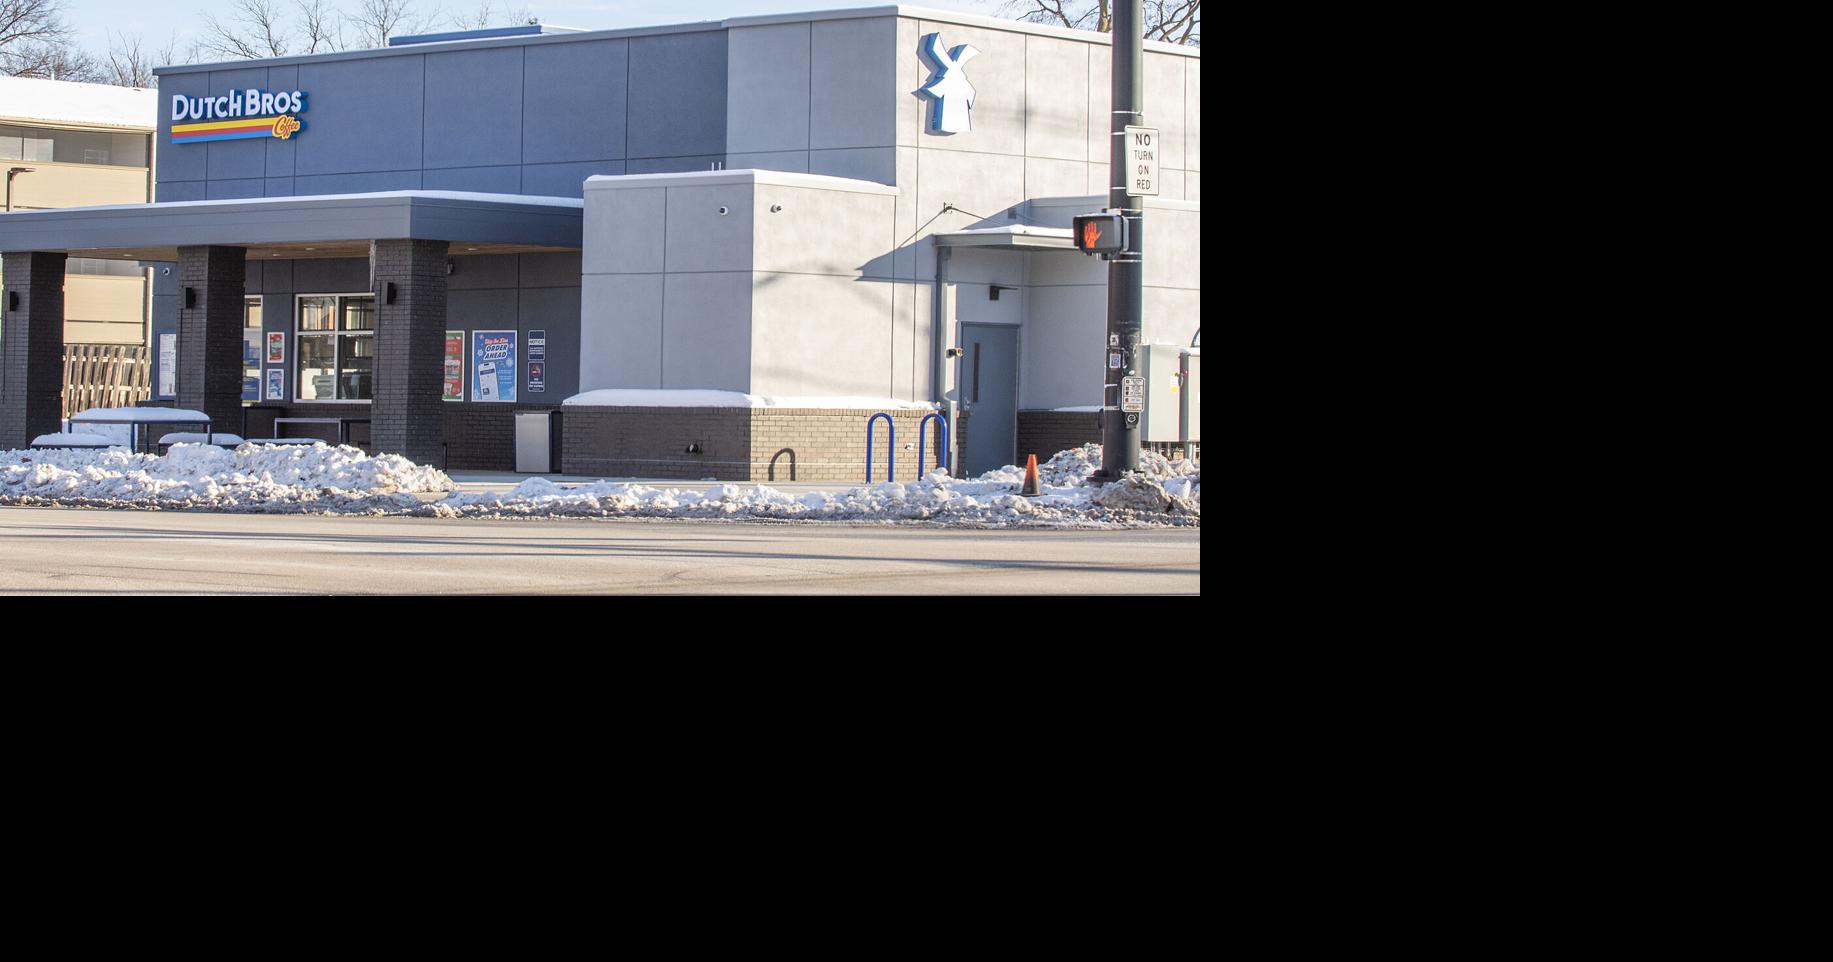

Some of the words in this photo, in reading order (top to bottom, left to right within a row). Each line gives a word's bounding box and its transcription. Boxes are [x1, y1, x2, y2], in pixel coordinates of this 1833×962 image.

[273, 115, 300, 139] Coffee
[1135, 133, 1151, 146] NO
[1133, 150, 1153, 161] TURN
[1138, 164, 1149, 175] ON
[1136, 179, 1151, 190] RED
[485, 344, 508, 352] ORDER
[484, 351, 507, 360] AHEAD
